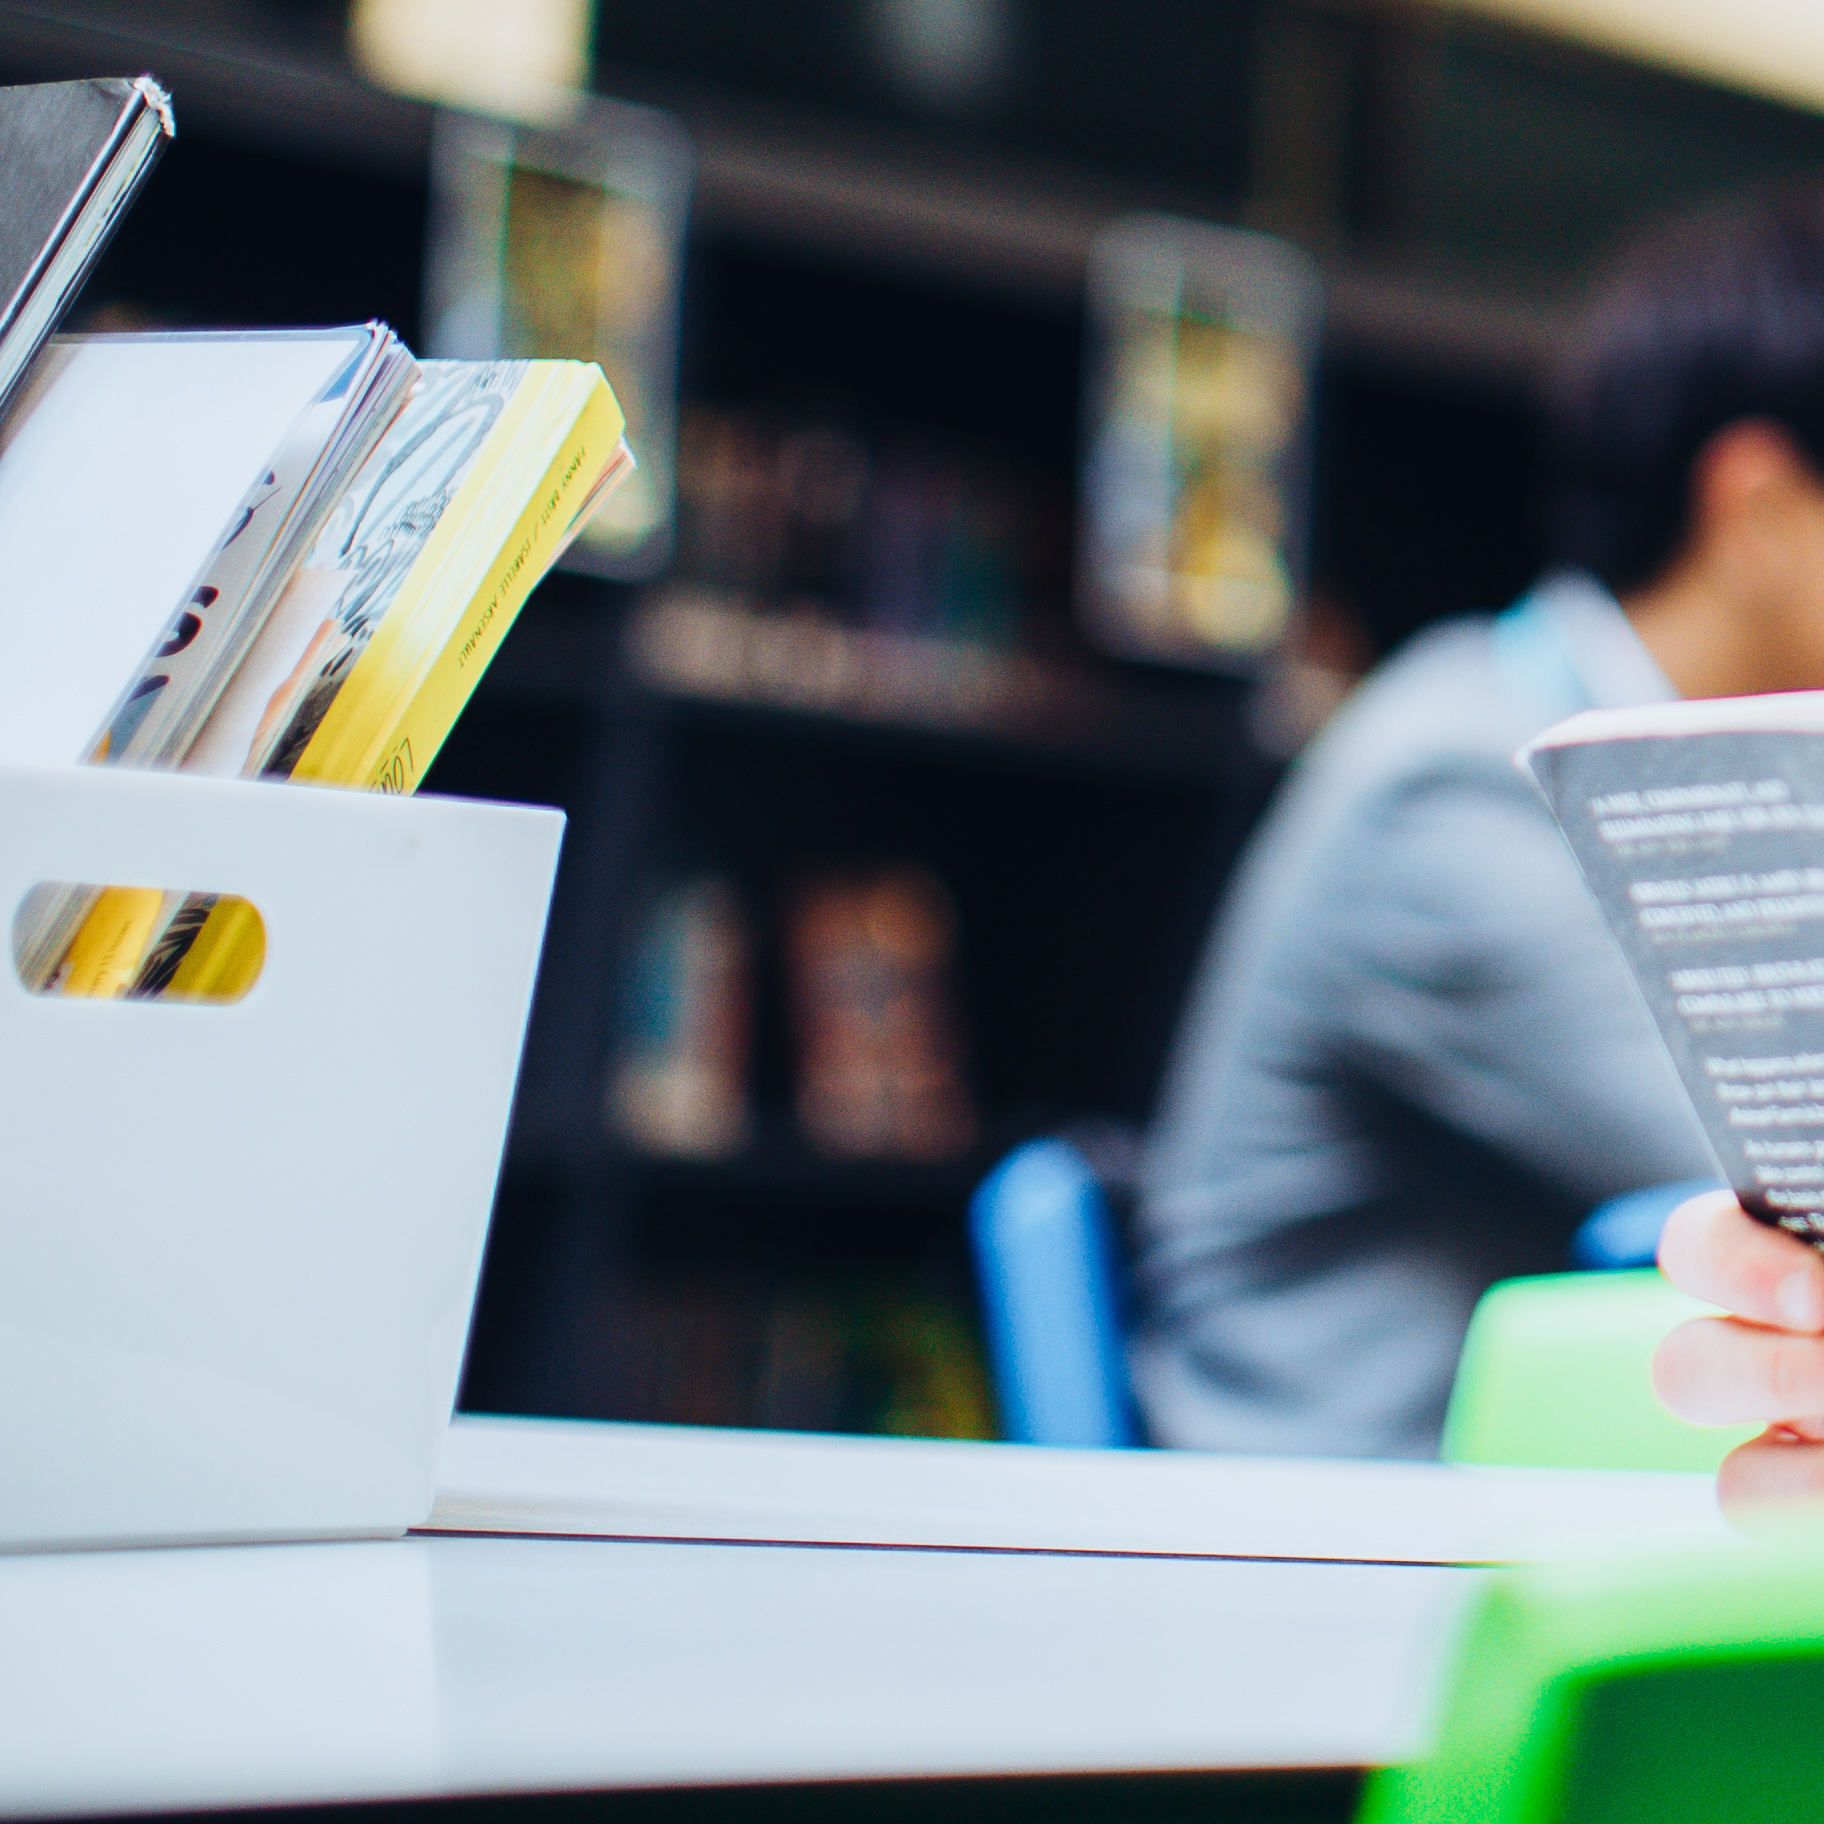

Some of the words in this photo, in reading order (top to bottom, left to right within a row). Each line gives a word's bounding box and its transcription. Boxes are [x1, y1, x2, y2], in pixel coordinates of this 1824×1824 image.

[559, 443, 586, 492] FANNY
[538, 488, 561, 527] BRITT
[497, 537, 533, 599] ISABELLE
[456, 592, 500, 671] ARSENAULT
